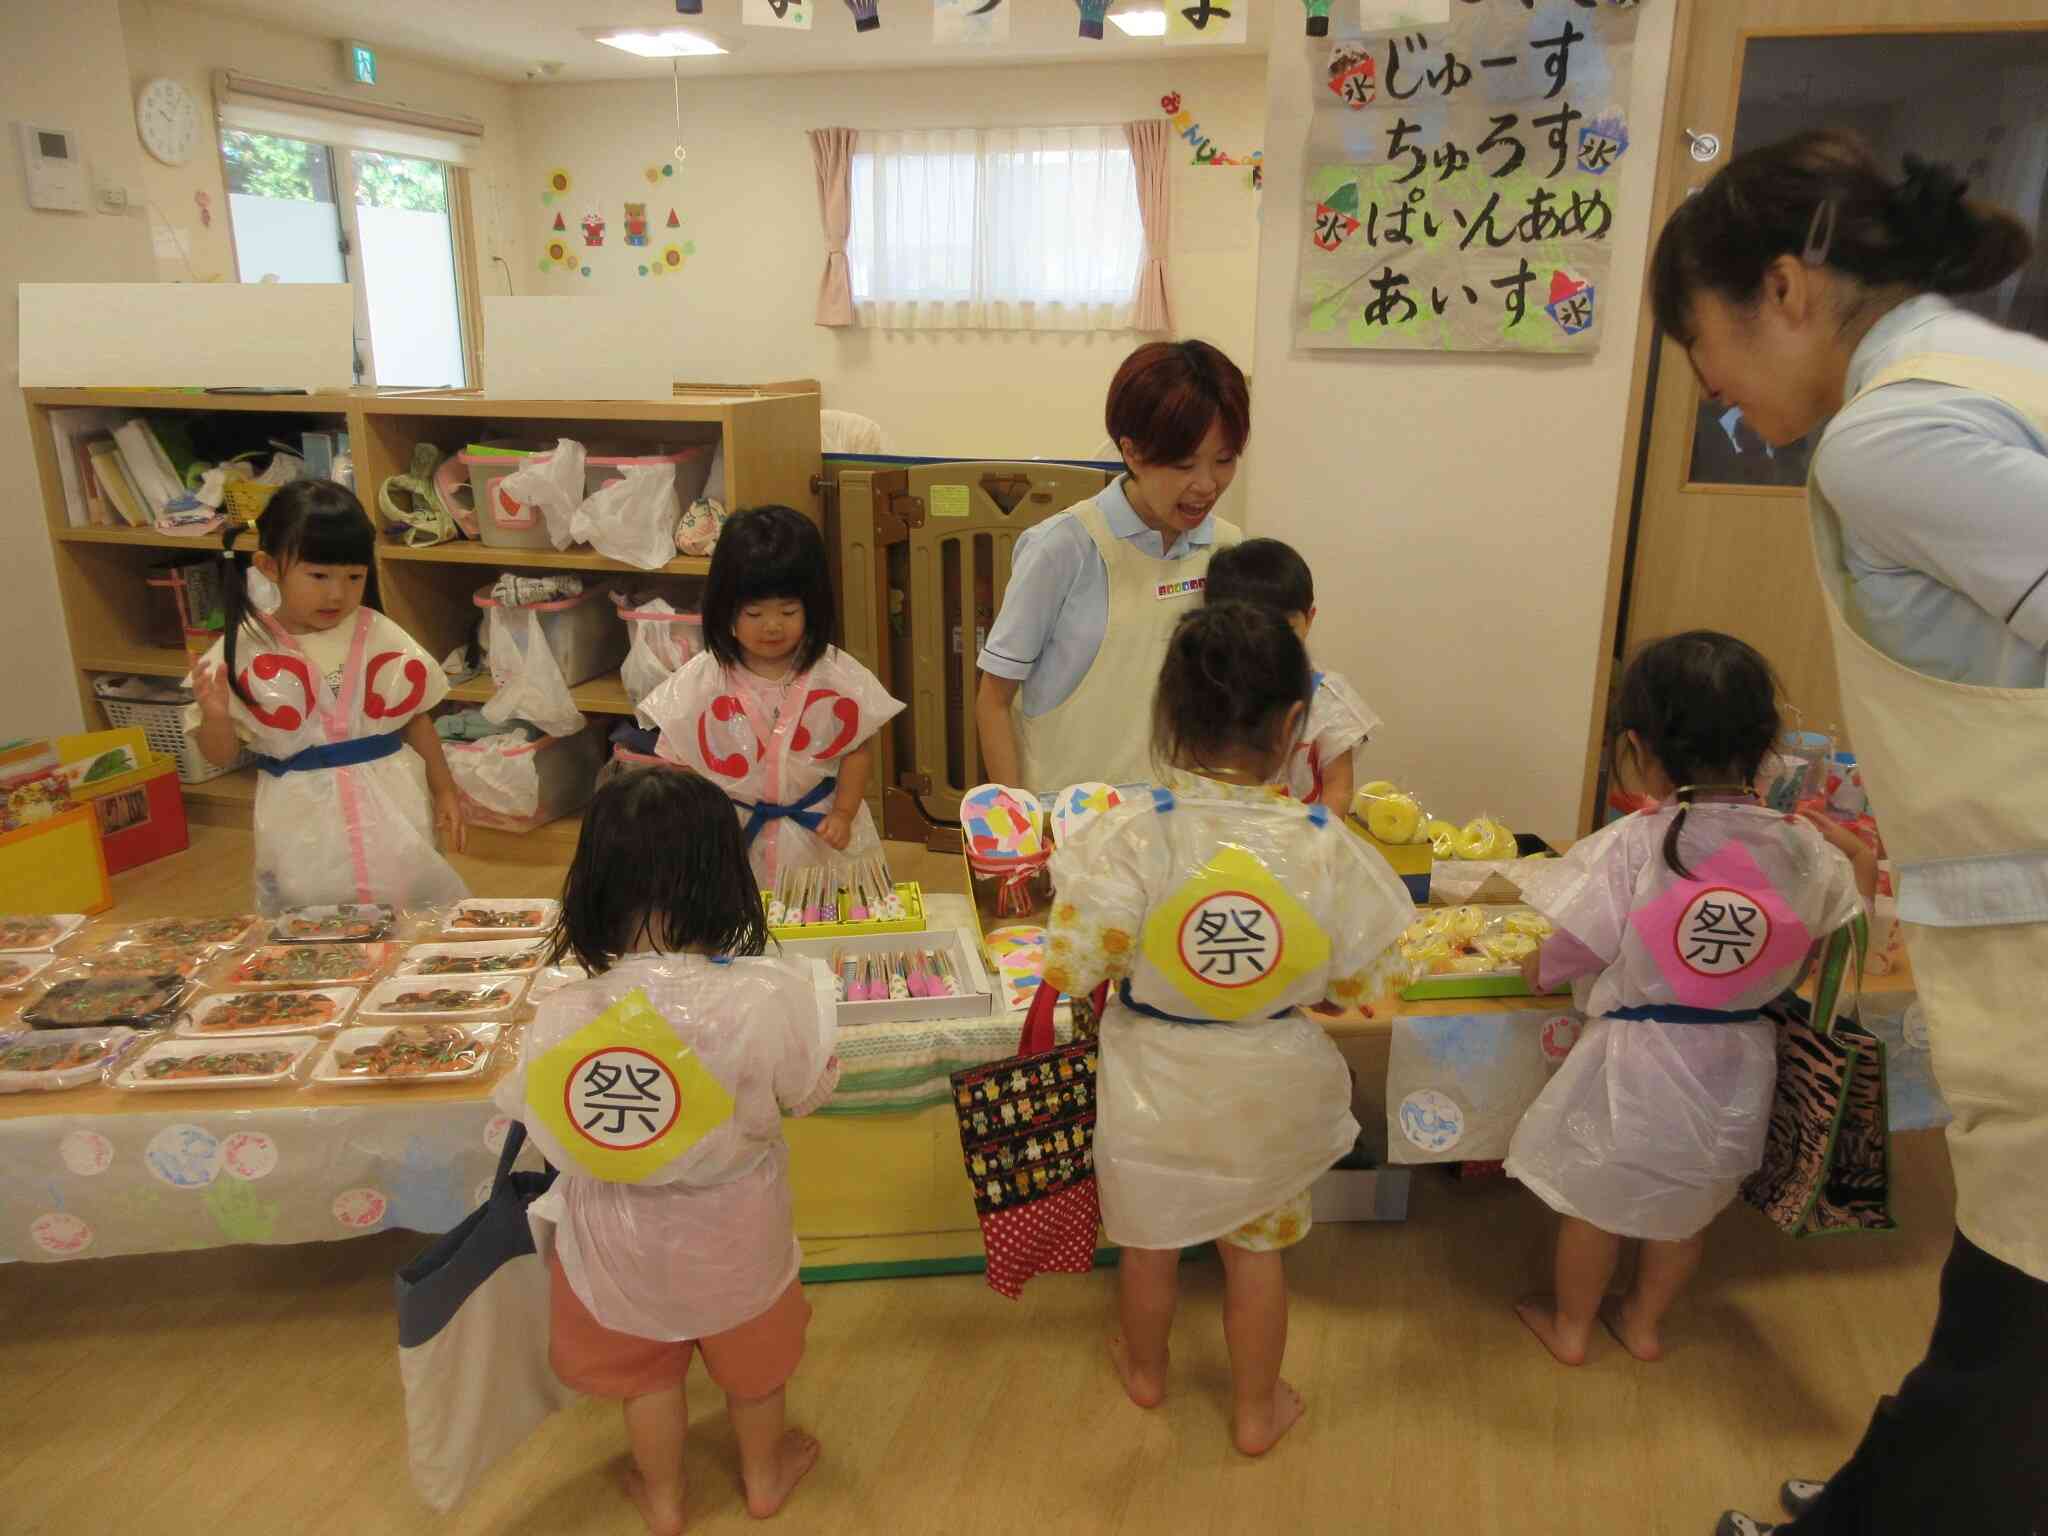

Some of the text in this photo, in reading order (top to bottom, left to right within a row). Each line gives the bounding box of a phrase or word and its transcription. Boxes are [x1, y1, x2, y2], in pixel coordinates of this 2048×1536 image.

[1385, 20, 1584, 99] じゅーす
[1386, 102, 1582, 183] ちゅろす
[1368, 188, 1612, 250] ぱいんあめ
[1364, 258, 1537, 328] あいす
[1560, 297, 1592, 328] 氷
[1194, 908, 1266, 975] 祭
[1687, 900, 1758, 964] 祭
[583, 1060, 662, 1134] 祭
